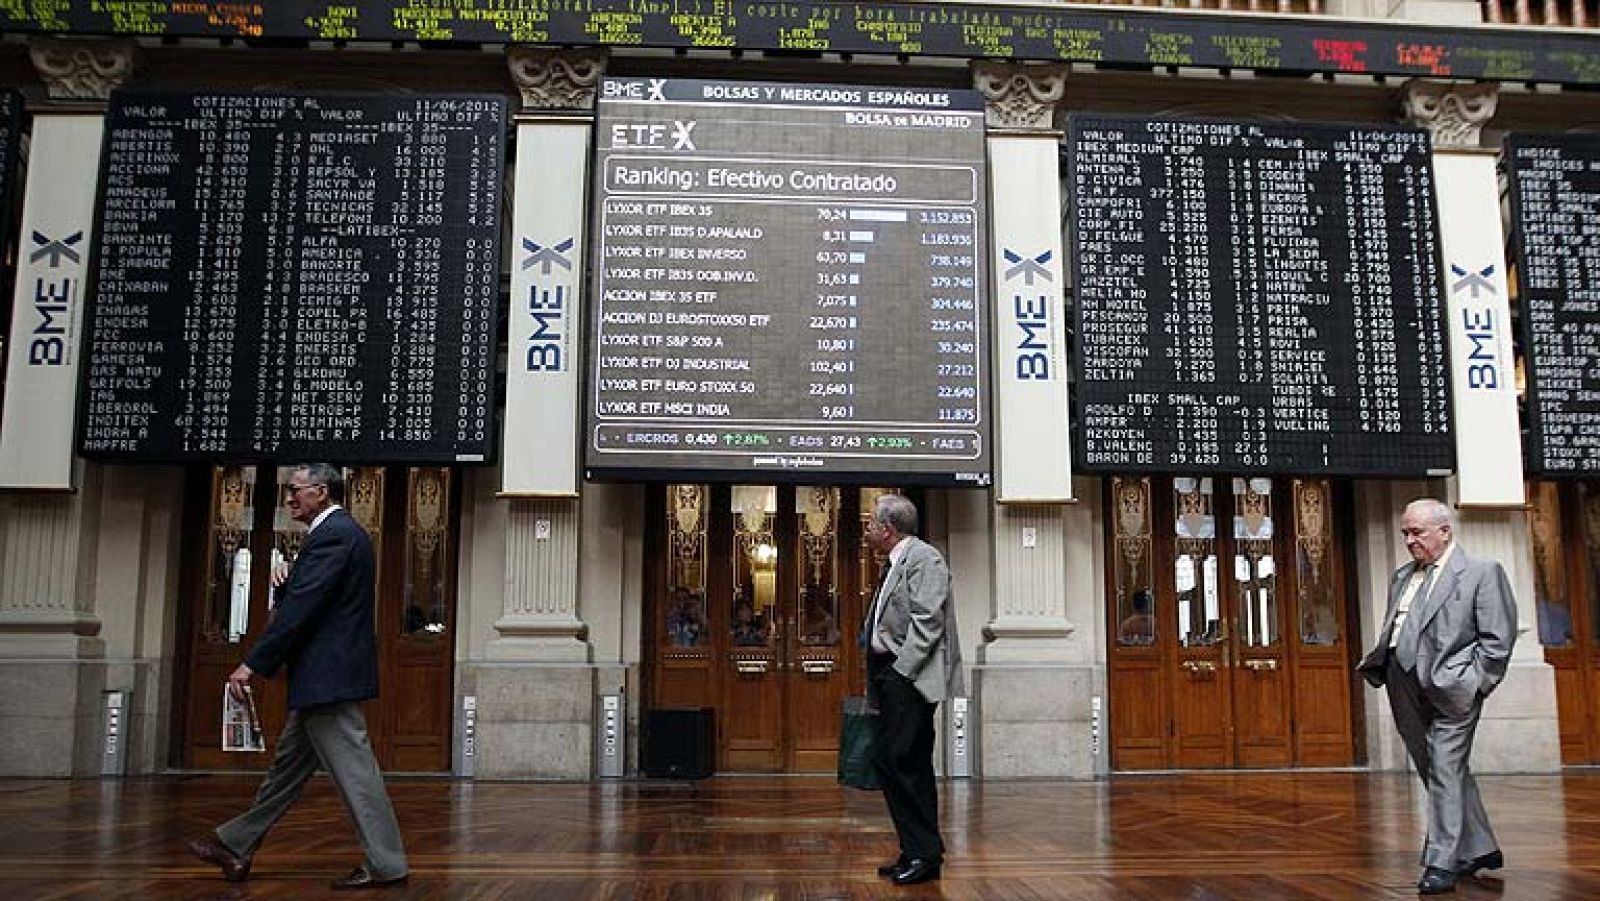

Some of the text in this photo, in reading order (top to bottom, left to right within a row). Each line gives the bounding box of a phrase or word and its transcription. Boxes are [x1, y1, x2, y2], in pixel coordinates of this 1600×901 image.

[603, 81, 643, 97] BME
[704, 86, 949, 106] BOLSAS Y MERCADOS ESPAÑOLES
[416, 100, 498, 111] 11/06/2012
[846, 113, 892, 126] BOLSA
[912, 115, 971, 127] MADRID
[615, 167, 897, 191] Ranking: Efectivo Contratado
[607, 203, 644, 215] LYXOR
[648, 204, 667, 215] ETF
[606, 225, 643, 236] LYXOR
[645, 225, 666, 236] ETF
[606, 246, 642, 257] LYXOR
[645, 248, 666, 257] ETF
[605, 268, 640, 278] LYXOR
[645, 269, 665, 280] ETF
[696, 292, 717, 303] ETF
[29, 278, 69, 365] BME
[750, 315, 771, 326] ETF
[527, 286, 562, 371] BME
[602, 335, 638, 345] LYXOR
[642, 336, 662, 346] ETF
[715, 337, 723, 347] A
[1015, 296, 1048, 380] BME
[1463, 308, 1496, 388] BME
[602, 356, 638, 367] LYXOR
[642, 358, 662, 368] ETF
[683, 359, 750, 369] INDUSTRIAL
[602, 379, 638, 390] LYXOR
[641, 380, 662, 391] ETF
[665, 381, 696, 391] EURO
[600, 403, 636, 413] LYXOR
[640, 403, 662, 413] ETF
[697, 404, 729, 415] INDIA
[831, 436, 861, 448] 27,43
